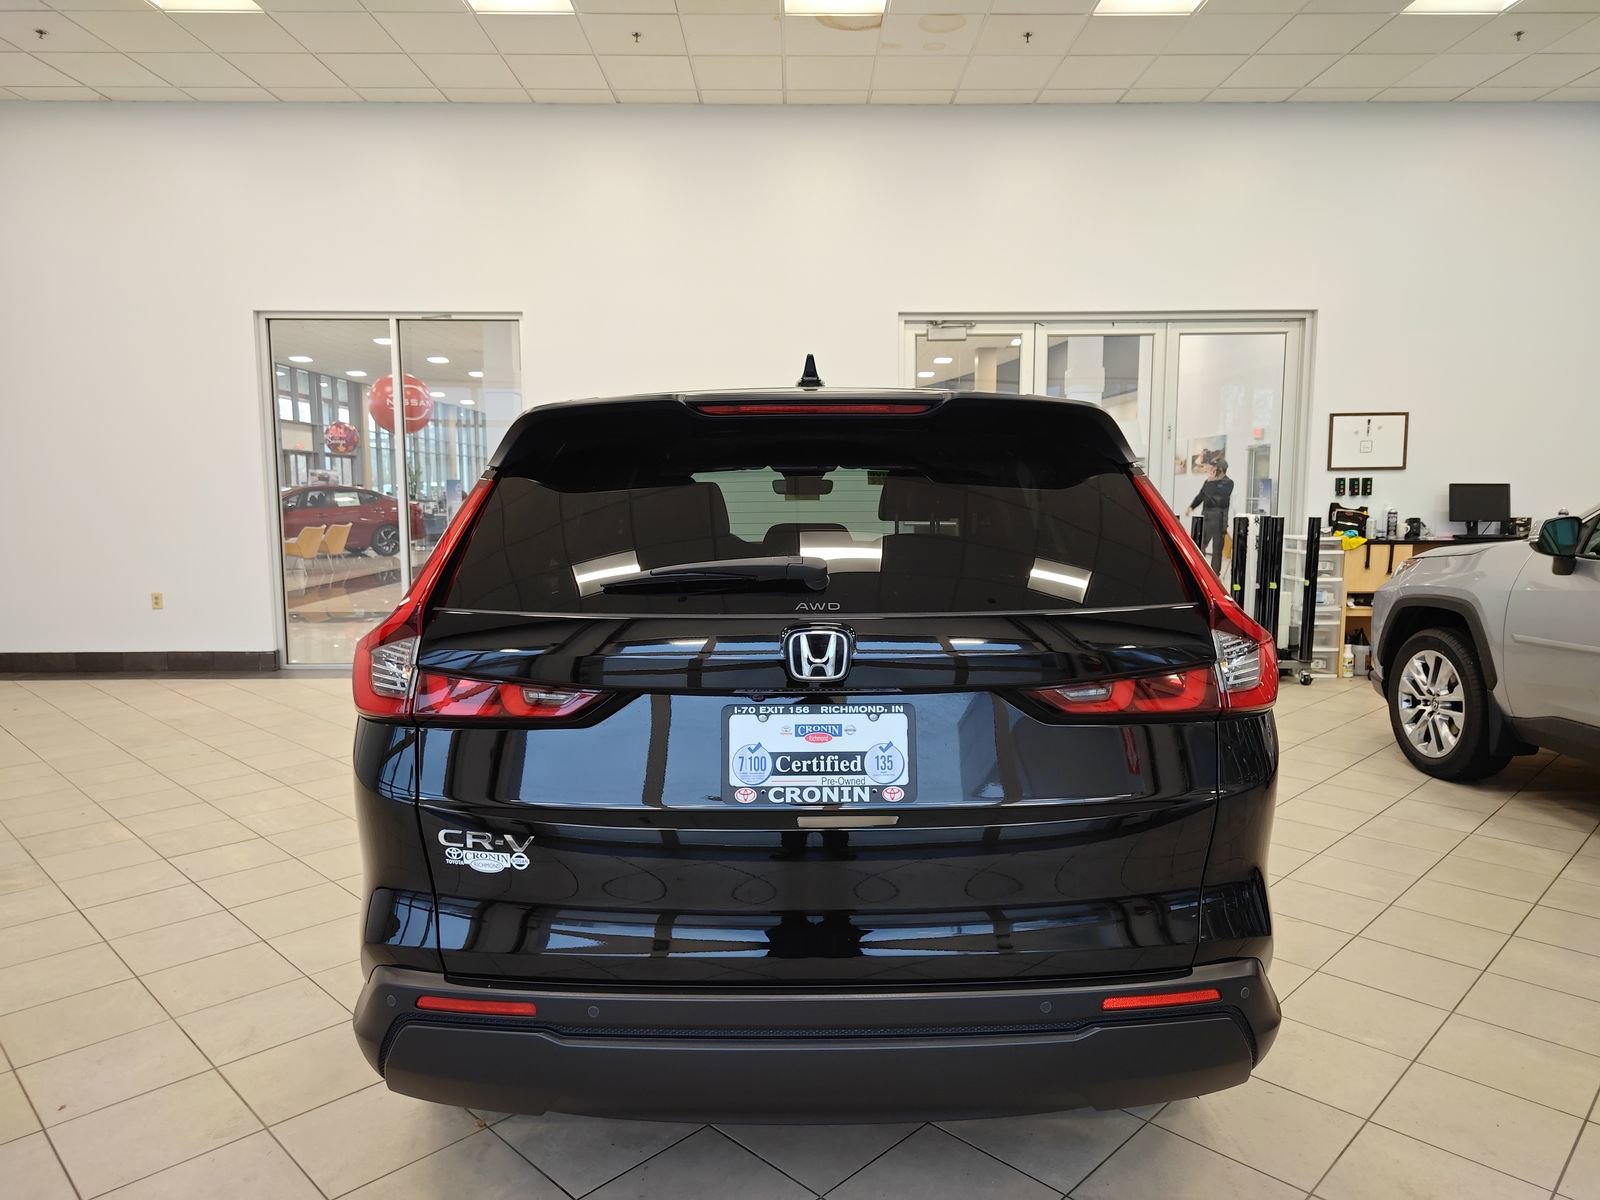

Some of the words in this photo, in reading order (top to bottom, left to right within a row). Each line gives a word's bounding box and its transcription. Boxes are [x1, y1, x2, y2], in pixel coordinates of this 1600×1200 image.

[386, 398, 432, 407] NSSAN
[795, 602, 841, 611] AWD
[734, 706, 756, 714] I-70
[759, 706, 785, 714] EXIT
[788, 706, 810, 714] 156
[891, 705, 904, 713] IN
[797, 725, 840, 736] CRONIN
[775, 755, 862, 773] Certified
[874, 754, 894, 771] 135
[821, 776, 866, 785] Pre-Owned
[767, 786, 870, 804] CRONIN
[437, 828, 535, 853] CR-V
[445, 858, 465, 866] TOYOTA
[464, 851, 509, 863] CRONIN
